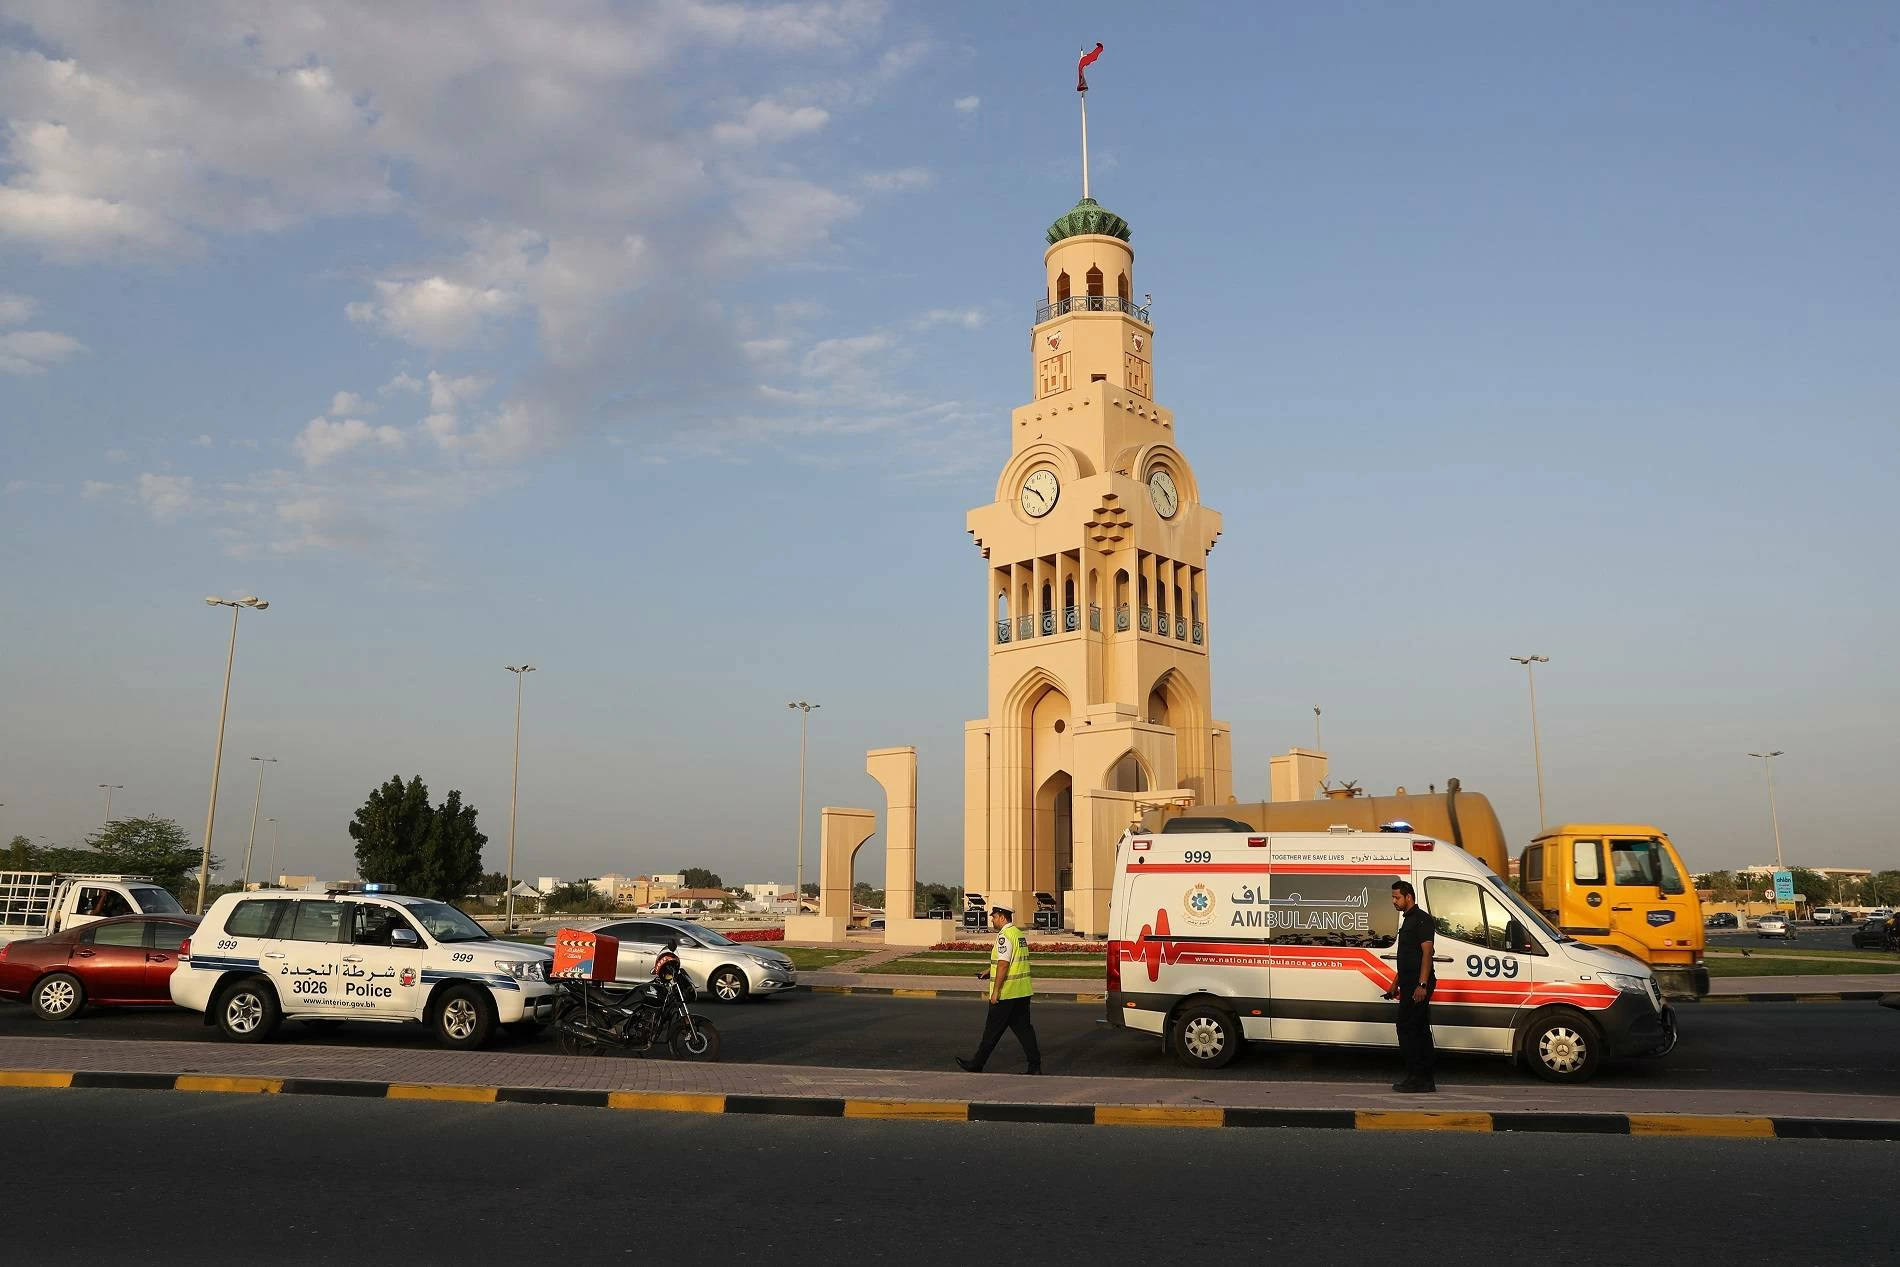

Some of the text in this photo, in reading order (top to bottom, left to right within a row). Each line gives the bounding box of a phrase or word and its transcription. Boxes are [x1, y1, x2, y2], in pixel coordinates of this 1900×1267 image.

[1184, 850, 1211, 863] 999
[1230, 910, 1369, 931] AMBULANCE
[217, 940, 238, 949] 999
[452, 952, 474, 962] 999
[1195, 956, 1343, 968] www.nationalambulance.gov.bh
[281, 963, 396, 981] شرطة النجدة
[1466, 954, 1519, 978] 999
[293, 980, 328, 995] 3026
[345, 982, 392, 998] Police
[303, 998, 376, 1009] www.interior.gov.bh
